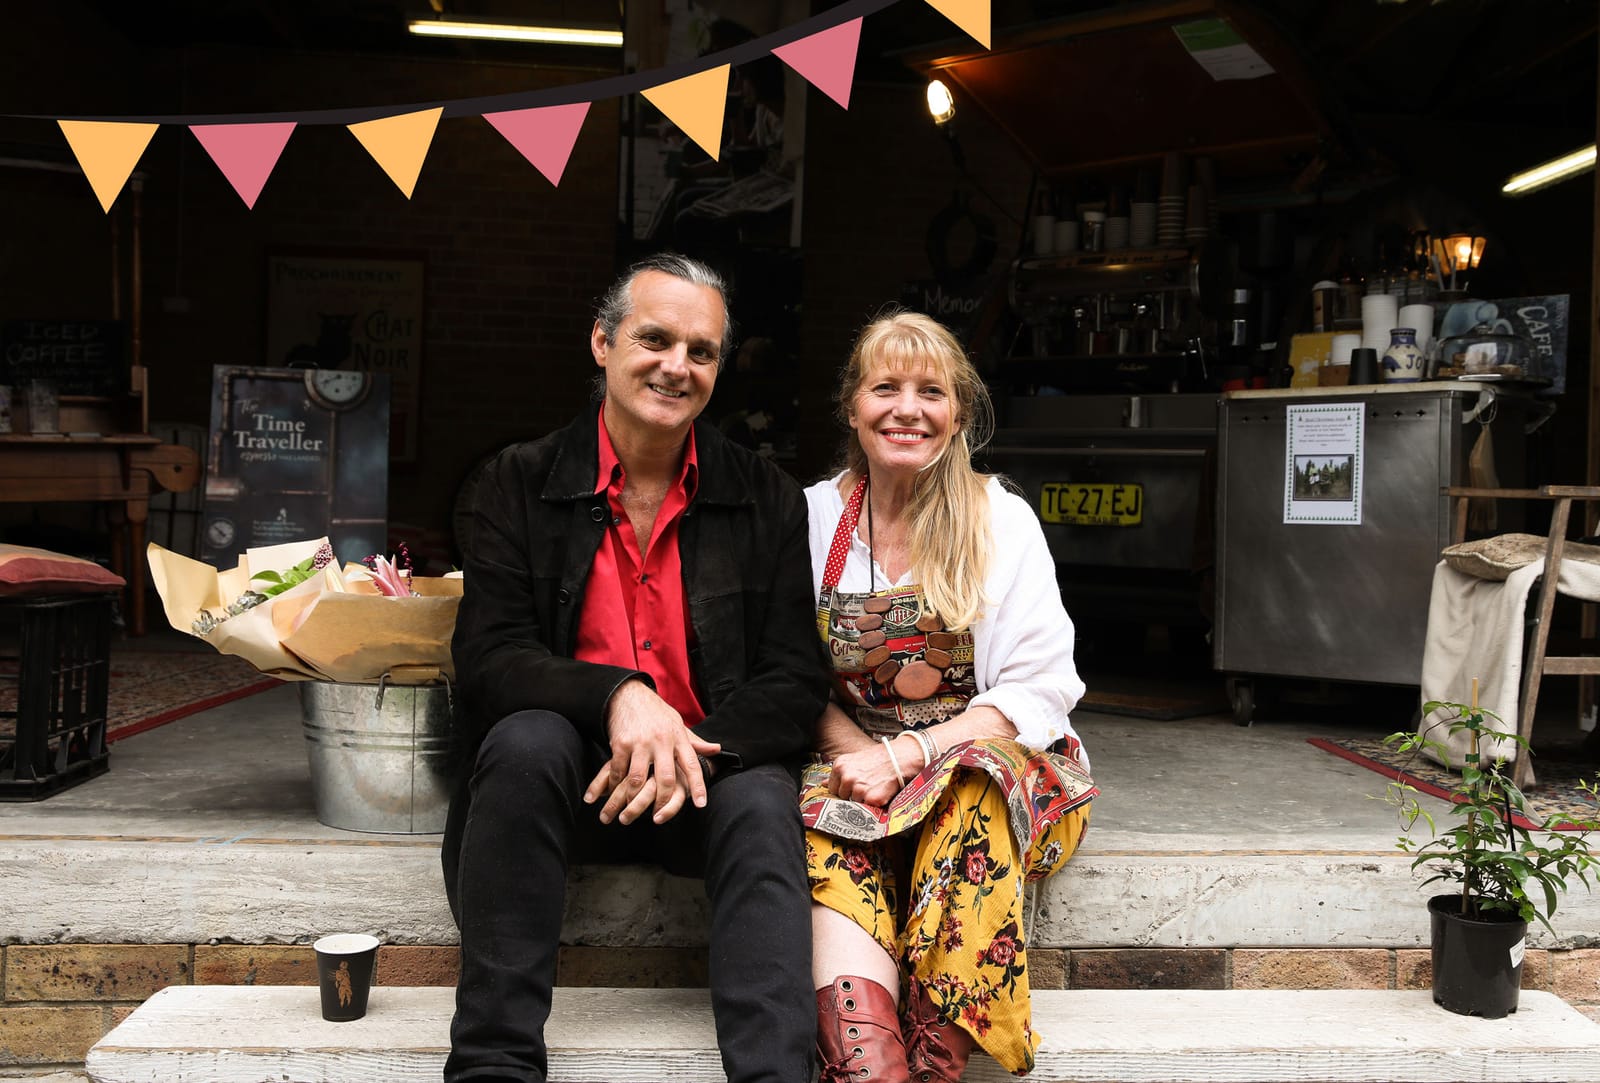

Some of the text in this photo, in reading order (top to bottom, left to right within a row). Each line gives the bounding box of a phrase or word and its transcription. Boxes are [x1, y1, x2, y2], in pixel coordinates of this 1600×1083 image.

[366, 310, 414, 342] CHAT
[353, 343, 409, 371] NOIR
[252, 413, 306, 432] Time
[232, 430, 323, 451] Traveller
